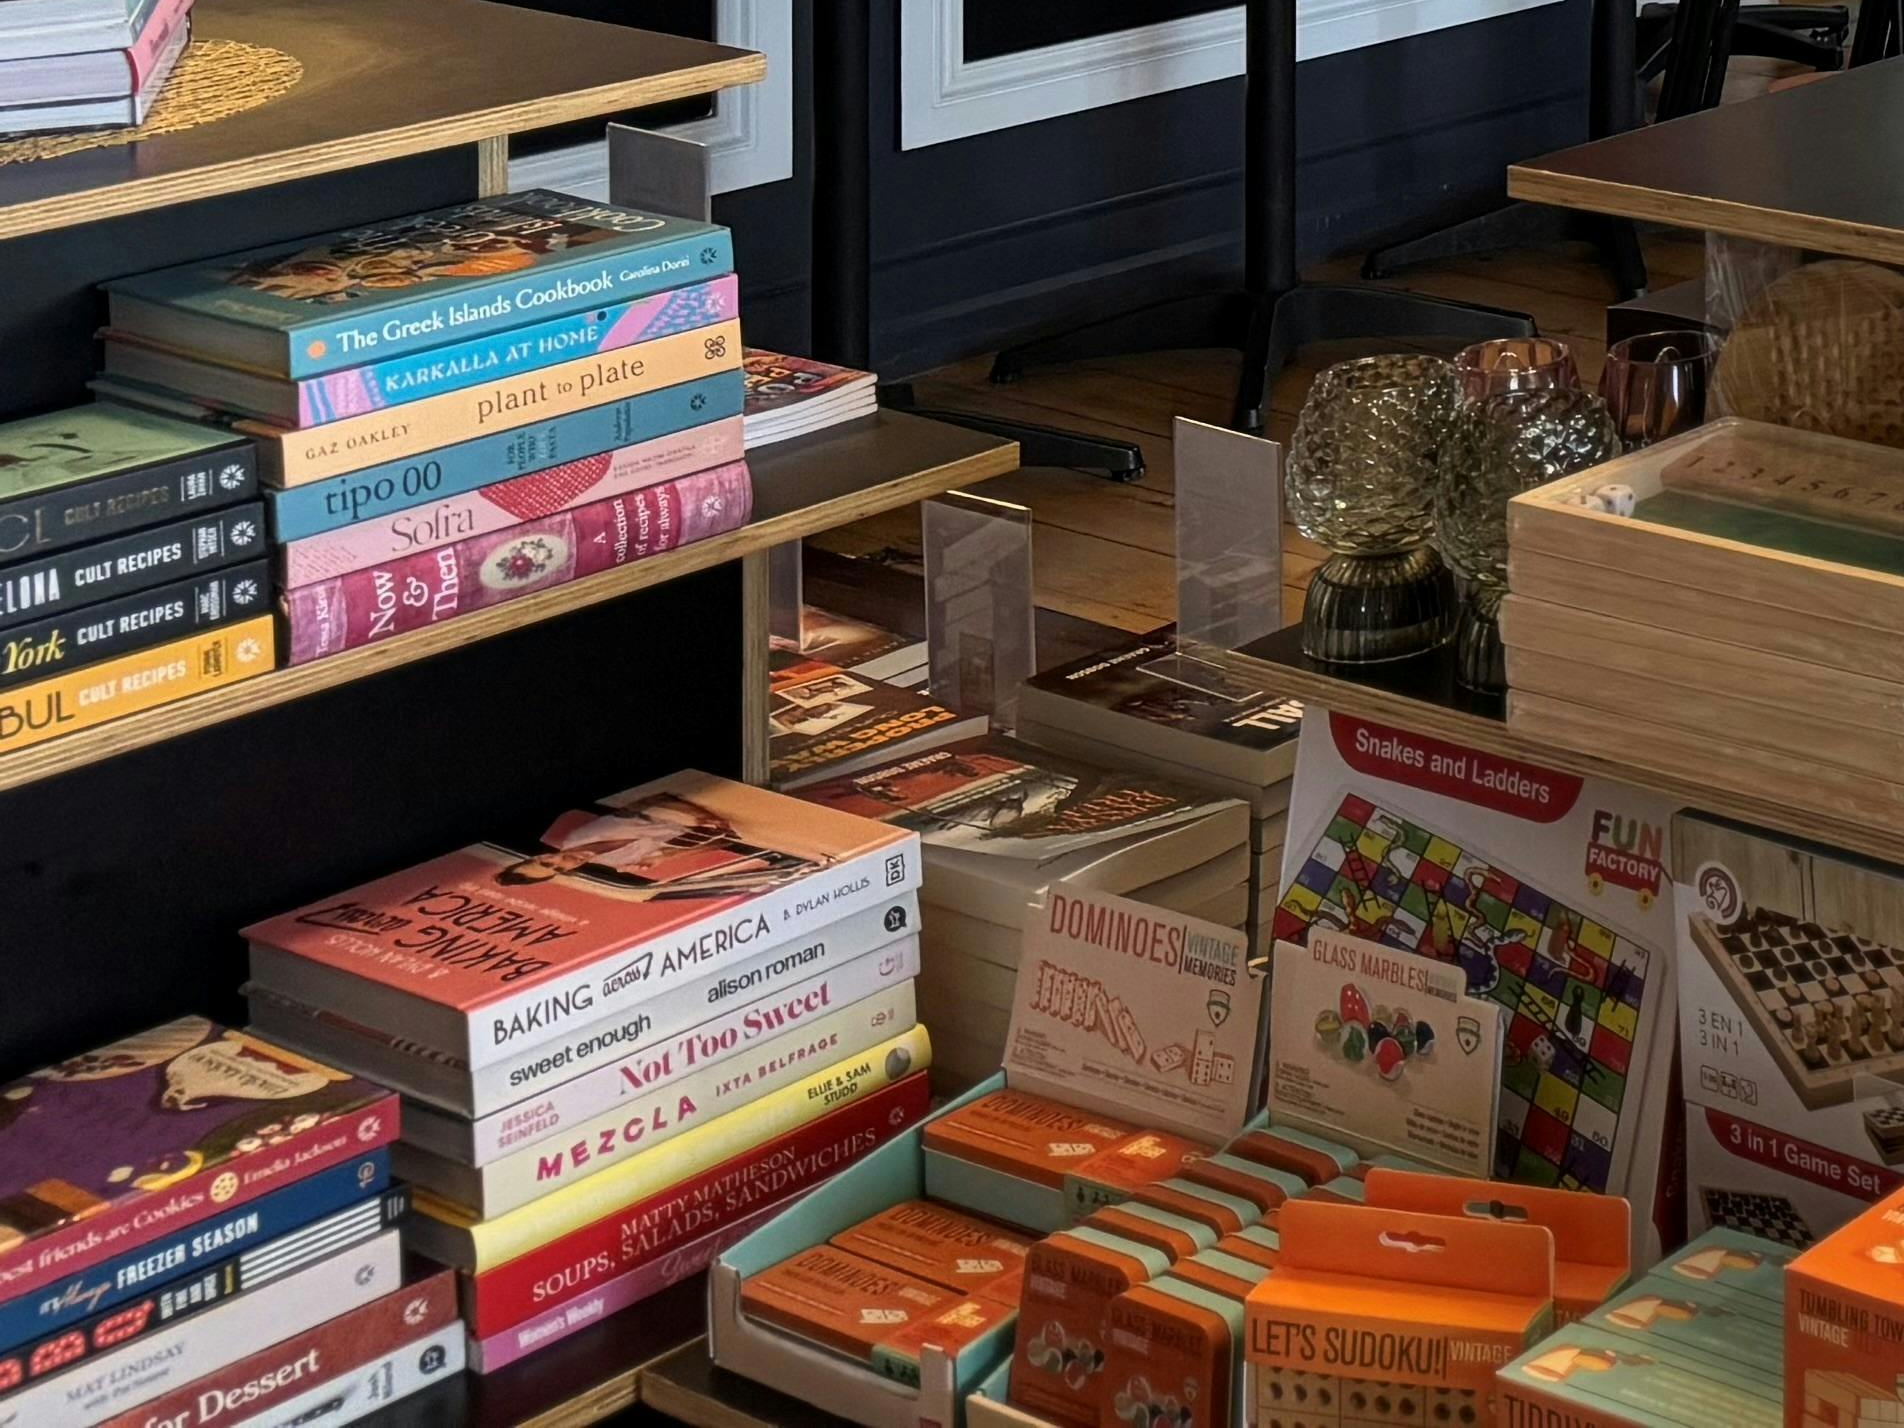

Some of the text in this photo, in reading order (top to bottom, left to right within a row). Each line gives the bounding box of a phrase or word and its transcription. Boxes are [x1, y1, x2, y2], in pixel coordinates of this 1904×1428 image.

[337, 265, 660, 353] The Greek Islands Cookbook Carolina
[385, 327, 599, 393] KARKALLA AT HOME
[305, 358, 645, 460] GAZ OAKLEY plant to plate
[324, 462, 442, 519] tipo 00
[75, 543, 182, 587] CULT RECIPES
[392, 507, 475, 553] Sofra
[369, 547, 457, 639] Now & Then
[1, 601, 184, 675] York CULT RECIPES
[1355, 729, 1550, 804] Snakes and Ladders
[887, 855, 904, 885] DK
[1589, 847, 1658, 881] FACTORY
[1590, 809, 1664, 861] FUN
[493, 876, 871, 1044] BAKING across AMERICA DYLAN HOLLIS
[1050, 894, 1240, 968] DOMINOES VINTAGE
[1184, 959, 1237, 986] MEMORIES
[509, 942, 825, 1088] sweet enough alison roman
[619, 981, 832, 1097] Not Too Sweet
[500, 1101, 555, 1132] JESSICA
[500, 1113, 559, 1148] SEINFELD
[537, 1033, 838, 1181] MEZCLA IXTA BELFRAGE
[39, 1133, 349, 1269] friends are Cookies Emelia Jackson
[532, 1126, 877, 1303] SOUPS, SALADS, SANDWICHES
[620, 1145, 796, 1241] MATTY MATHESON
[117, 1211, 260, 1291] FREEZER SEASON
[1798, 1312, 1849, 1349] VINTAGE
[199, 1348, 320, 1425] Dessert
